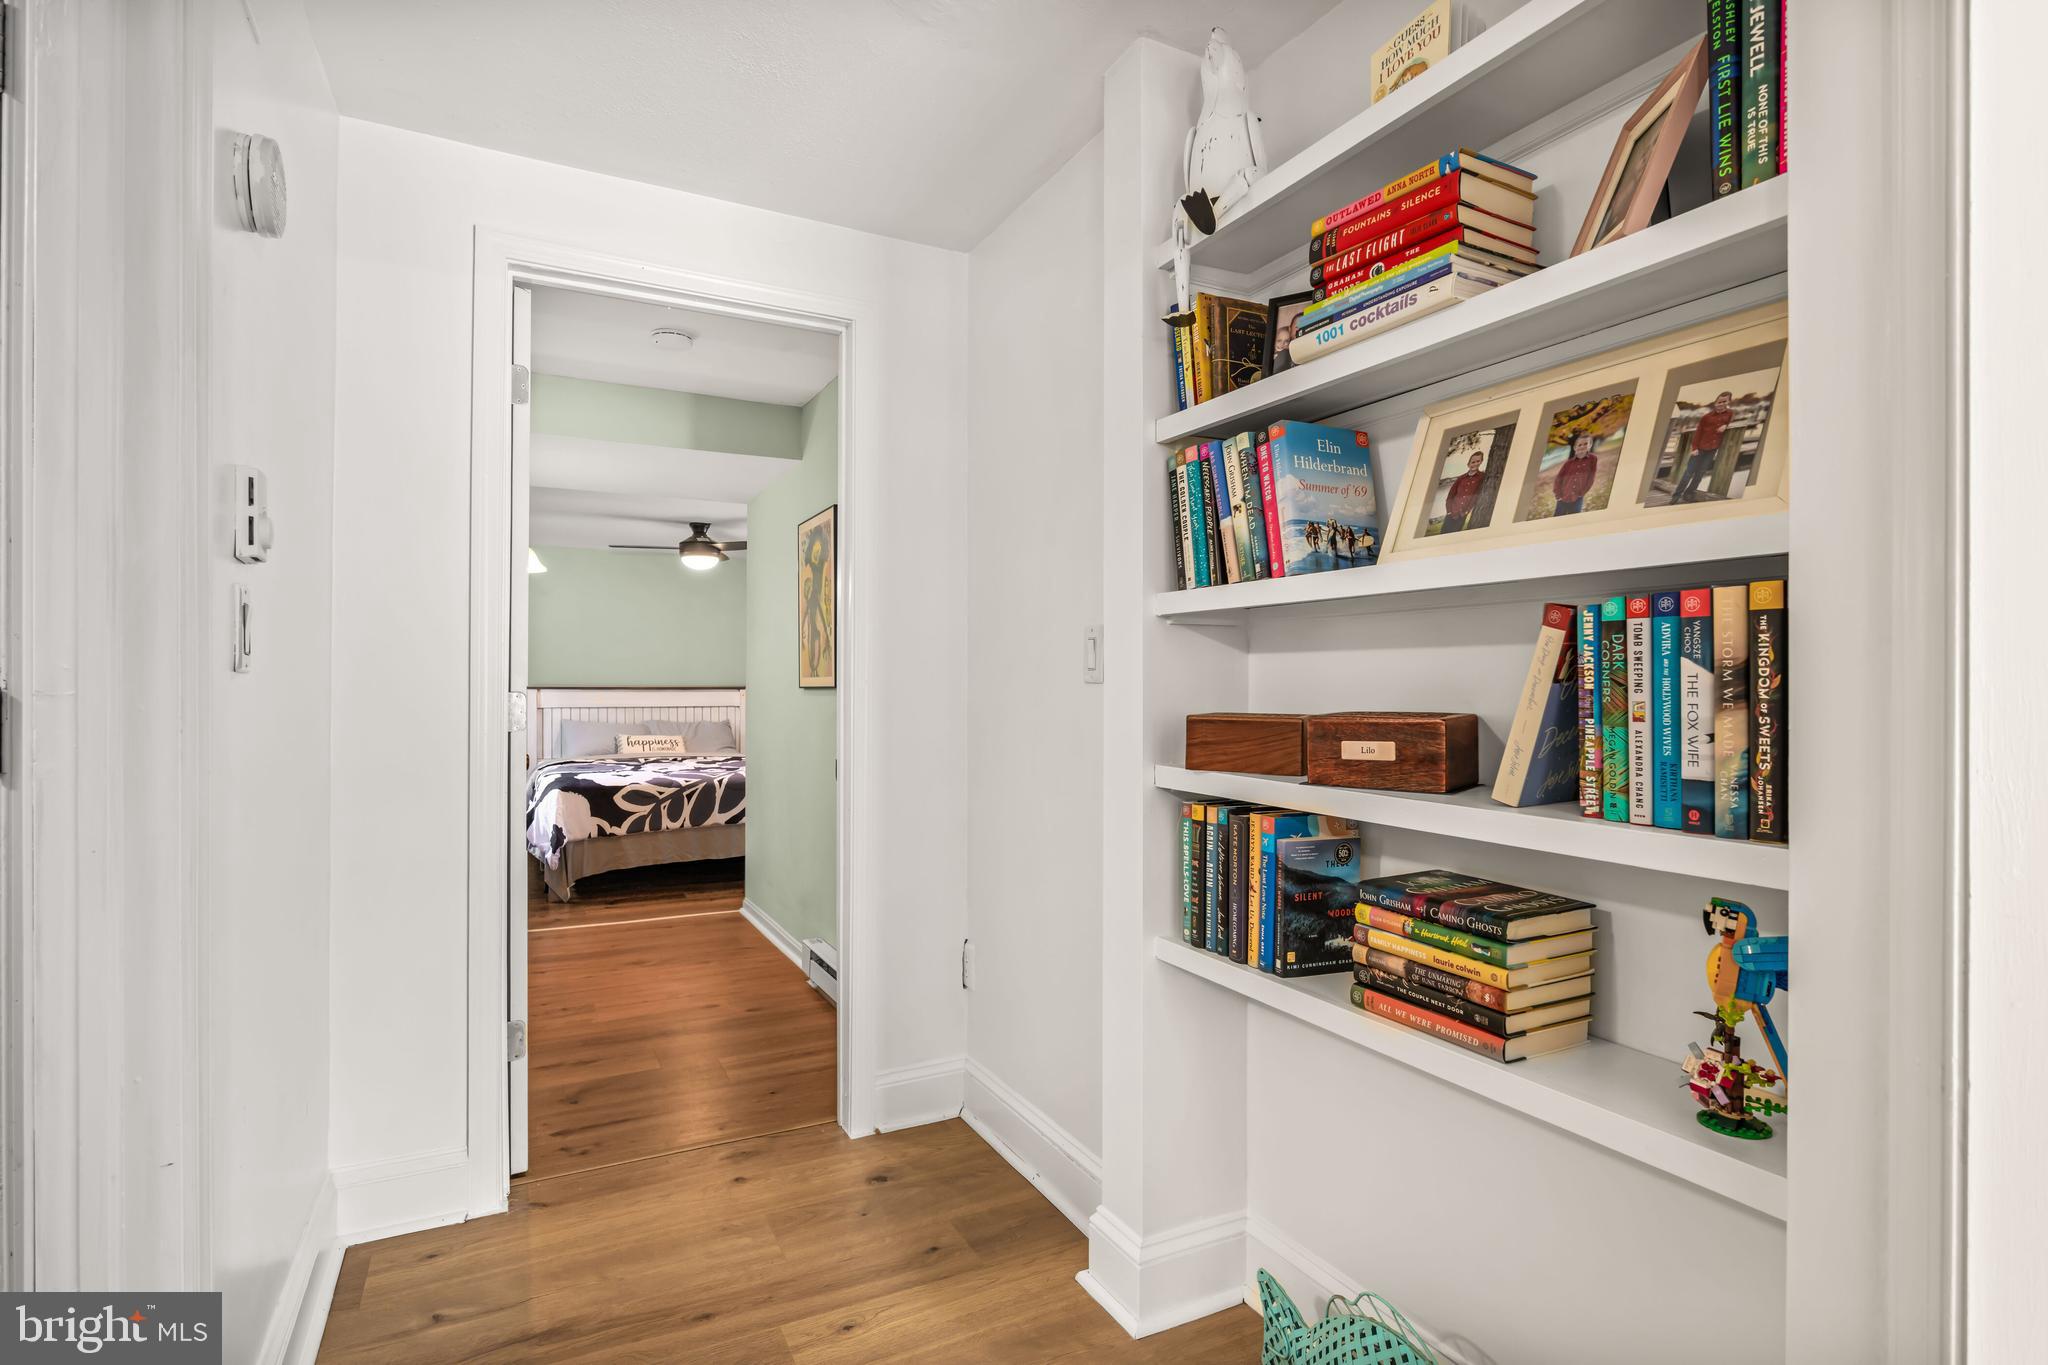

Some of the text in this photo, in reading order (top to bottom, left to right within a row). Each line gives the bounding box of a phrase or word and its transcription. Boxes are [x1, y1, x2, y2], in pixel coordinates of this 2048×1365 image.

[1393, 15, 1425, 48] GUESS
[1711, 1, 1721, 50] ELSTON
[1725, 0, 1736, 42] SHLEY
[1749, 5, 1765, 78] JEWELL
[1381, 15, 1439, 70] HOW MUCH
[1387, 48, 1415, 78] LOVE
[1417, 24, 1441, 51] YOU
[1717, 54, 1732, 177] FIRST LIE WINS
[1747, 107, 1757, 152] IS TRUE
[1758, 84, 1769, 164] NONE OF THIS
[1326, 165, 1436, 226] OUTLAWED ANNA NORTH
[1342, 208, 1392, 237] FOUNTAINS
[1400, 186, 1441, 211] SILENCE
[1335, 248, 1362, 272] LAST
[1366, 229, 1406, 260] FLIGHT
[1405, 246, 1421, 257] THE
[1327, 269, 1365, 290] GRAHAM
[1316, 323, 1345, 345] 1001
[1349, 292, 1418, 331] cocktails
[1239, 450, 1250, 481] WHEN
[1293, 455, 1368, 477] Hilderbrand
[1317, 439, 1341, 455] Elin
[1201, 461, 1212, 503] NECESSARY
[1224, 443, 1237, 498] JOHN GRISHAM
[1244, 482, 1253, 499] I'M
[1259, 445, 1272, 501] ONE TO WATCH
[1298, 479, 1368, 499] Summer of '69
[1179, 486, 1187, 512] GOLDEN
[1246, 502, 1256, 530] DEAD
[1181, 515, 1189, 541] COUPLE
[1205, 506, 1214, 535] PEOPLE
[1583, 609, 1595, 690] JENNY JACKSON
[1612, 634, 1625, 670] DARK
[1633, 622, 1643, 694] TOMB SWEEPING
[1683, 626, 1691, 654] CHOO
[1692, 620, 1701, 659] YANGSZE
[1721, 631, 1734, 681] STORM
[1601, 640, 1612, 703] CORNERS
[1757, 614, 1771, 770] THE KINGDOM OF SWEETS
[1662, 677, 1672, 726] HOLLYWOOD
[1722, 687, 1734, 710] WE
[1686, 673, 1700, 768] THE FOX WIFE
[1722, 715, 1735, 757] MADE
[627, 735, 679, 752] happiness
[1361, 745, 1376, 755] Lilo
[1635, 729, 1644, 777] ALEXANDRA
[1662, 727, 1672, 756] WIVES
[1584, 718, 1598, 815] PINEAPPLE STREET
[1608, 726, 1617, 799] MEGAN GOLDIN
[1635, 781, 1644, 809] CHANG
[1720, 770, 1729, 801] CHAN
[1729, 763, 1739, 809] VANESSA
[1757, 776, 1765, 814] JOHANSEN
[1765, 784, 1773, 807] ERIKA
[1205, 862, 1213, 887] AGAIN
[1294, 891, 1323, 902] SILENT
[1327, 908, 1355, 919] WOODS
[1359, 888, 1502, 936] JOHN GRISHAM CAMINO GHOSTS
[1370, 936, 1481, 977] FAMILY HAPPINESS laurie colwin
[1450, 936, 1468, 948] Hotel
[1414, 966, 1463, 988] THE UNMAKING
[1396, 986, 1464, 1016] THE COUPLE NEXT DOOR
[1378, 1003, 1479, 1047] ALL WE WERE PROMISED
